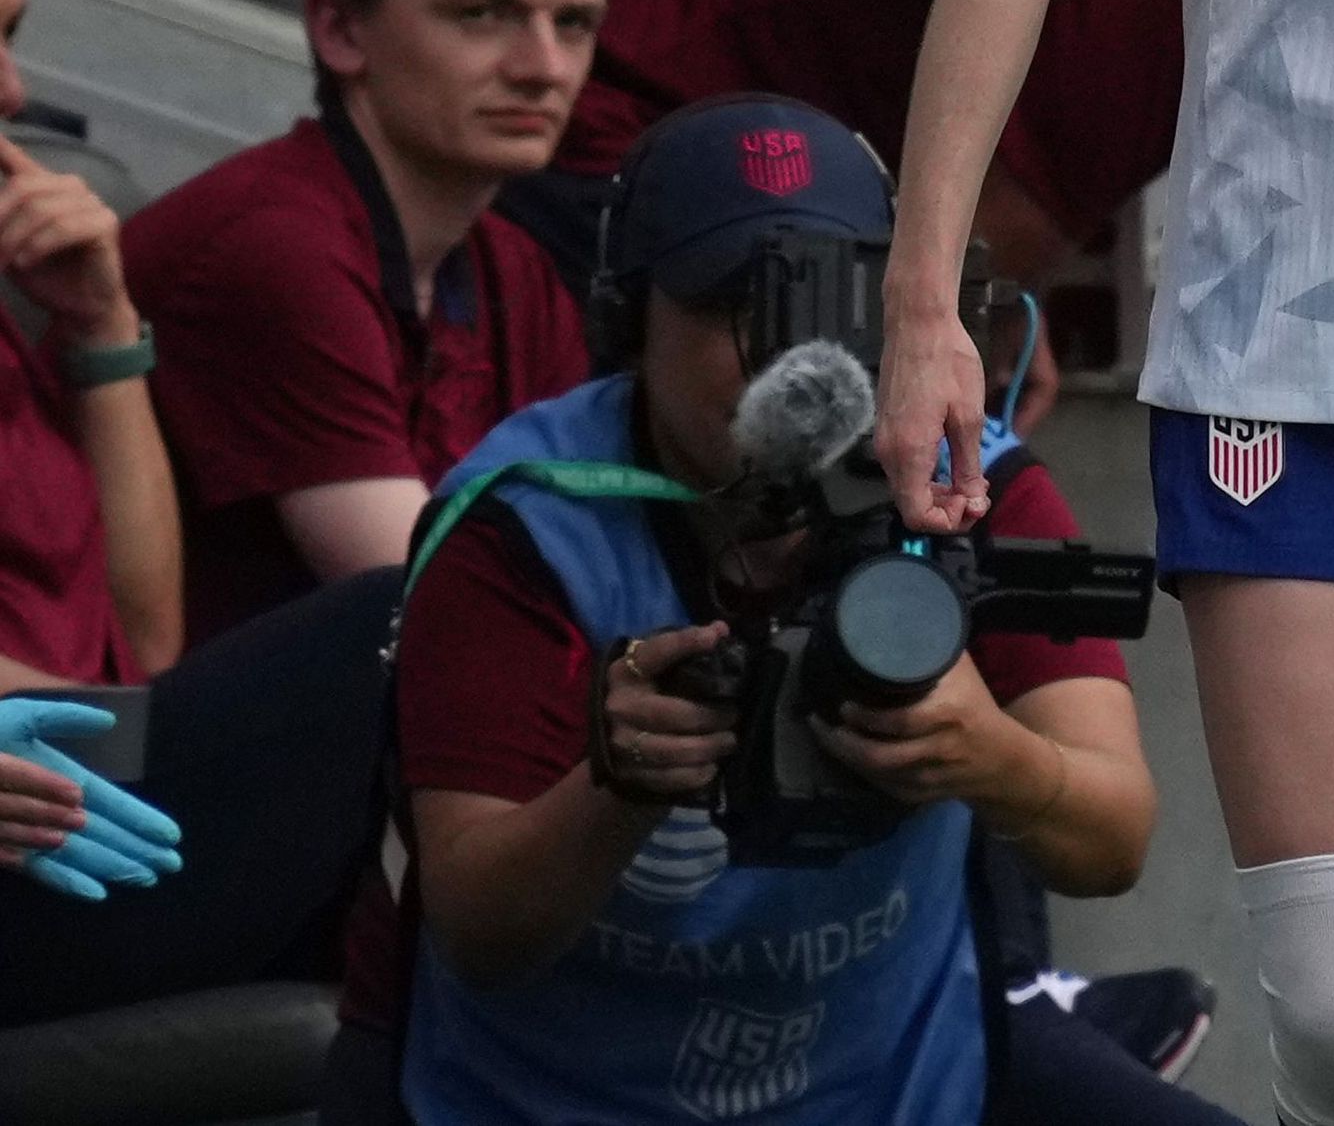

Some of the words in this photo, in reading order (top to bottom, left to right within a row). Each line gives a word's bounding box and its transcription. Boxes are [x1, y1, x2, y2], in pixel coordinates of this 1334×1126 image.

[743, 130, 802, 157] USA
[591, 921, 746, 979] TEAM
[762, 887, 908, 982] VIDEO
